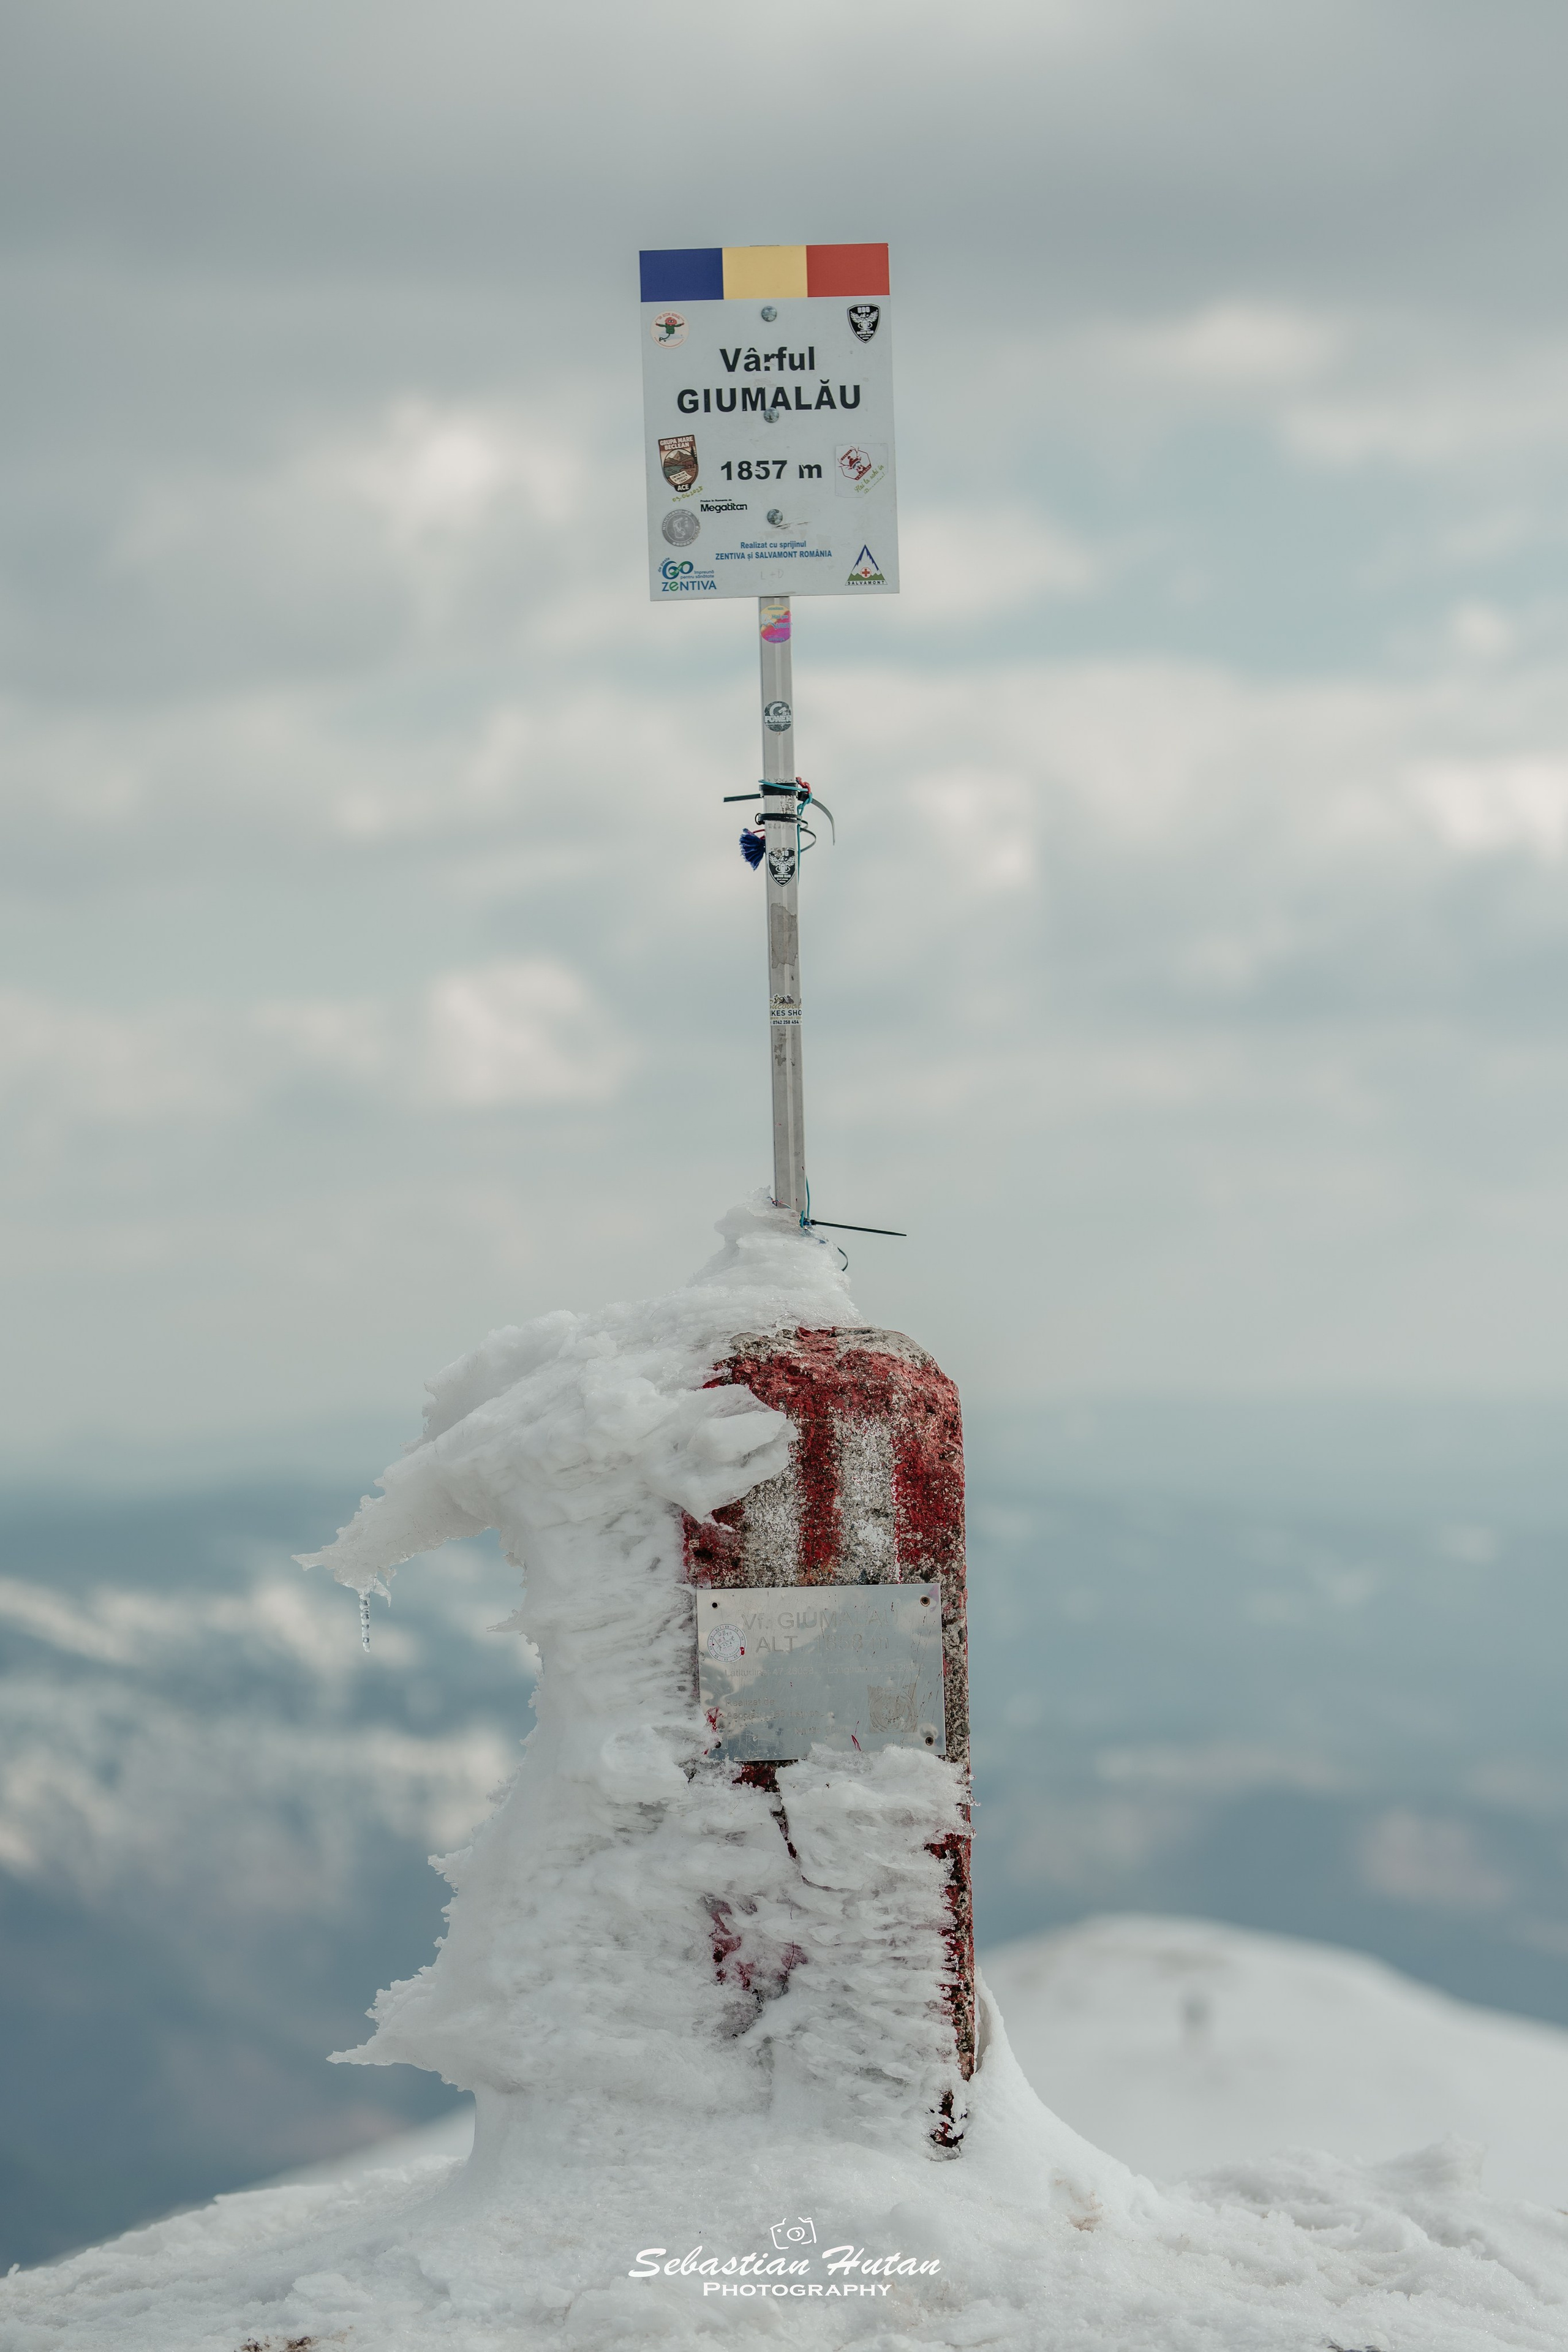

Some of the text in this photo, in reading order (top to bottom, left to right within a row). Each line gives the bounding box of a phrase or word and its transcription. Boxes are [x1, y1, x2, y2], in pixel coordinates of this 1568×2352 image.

[719, 346, 815, 372] Vârful
[677, 379, 861, 414] GIUMALĂU
[720, 460, 822, 481] 1857 m
[700, 503, 747, 513] Megatitan
[780, 541, 806, 549] sprijinul
[747, 552, 753, 561] și
[799, 549, 832, 558] ROMÂNIA
[764, 1697, 775, 1706] de
